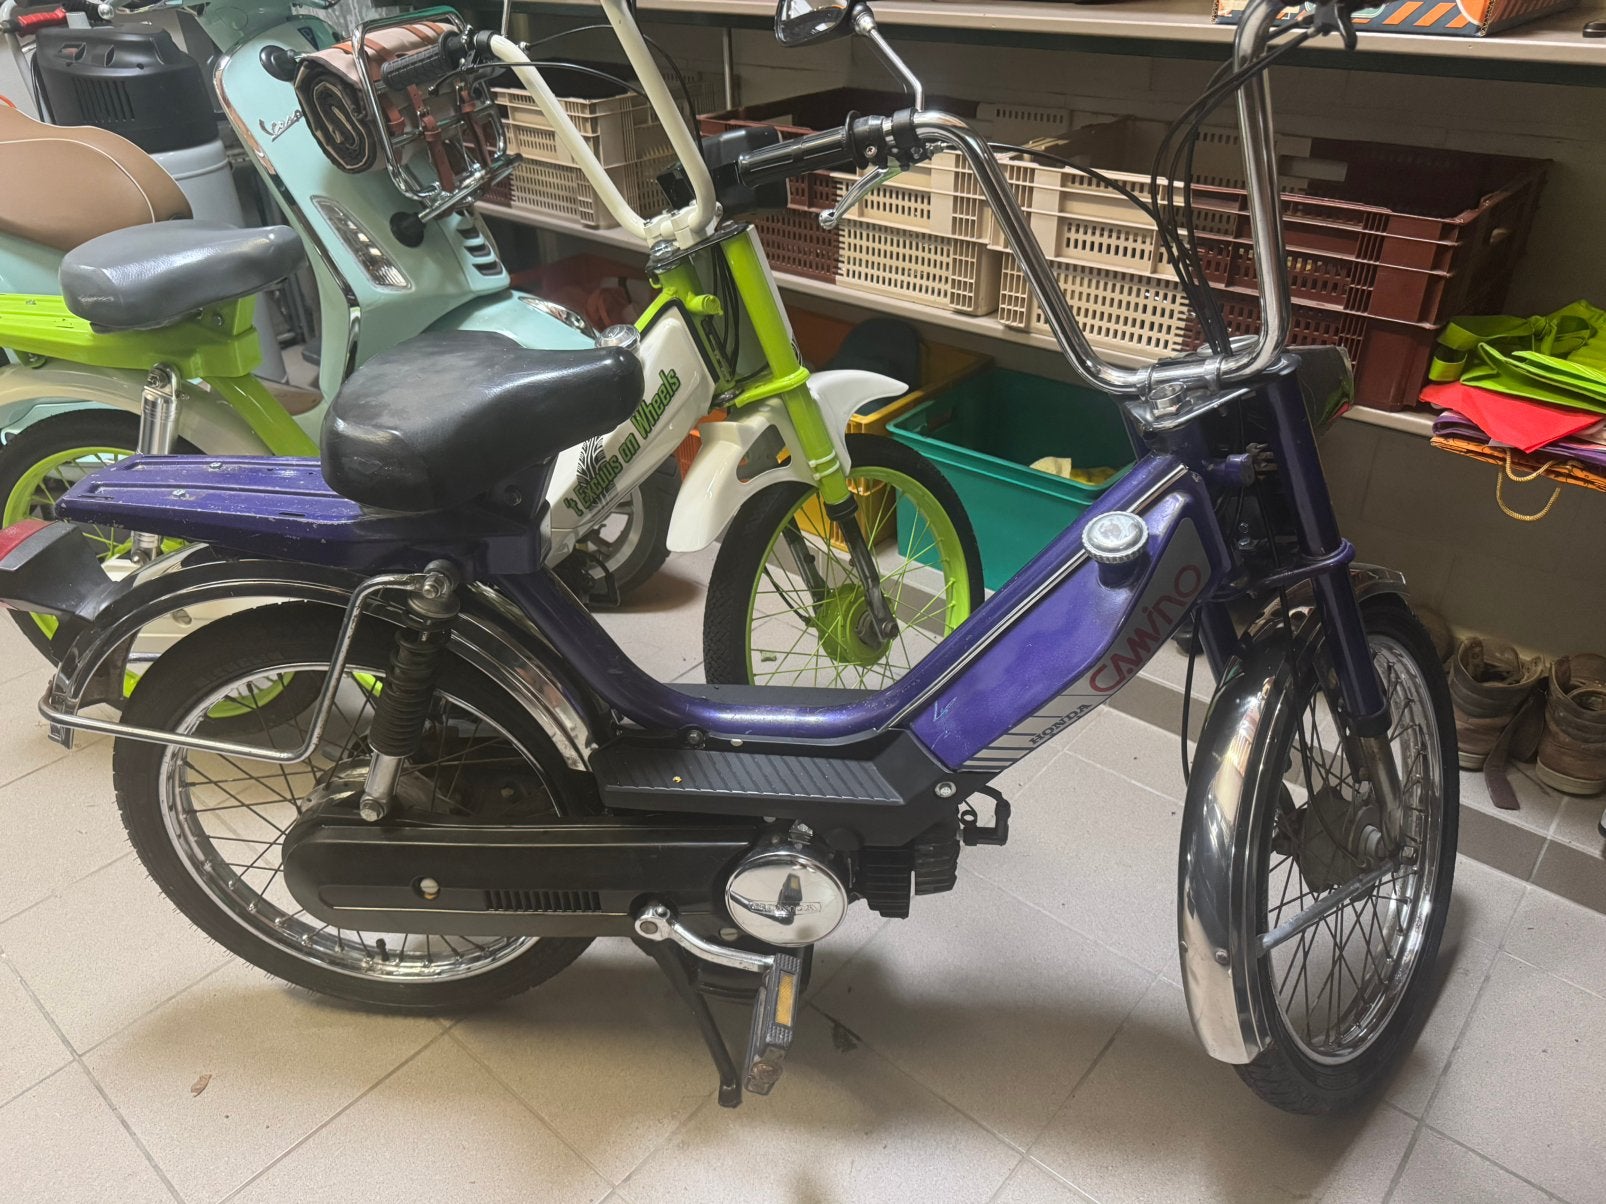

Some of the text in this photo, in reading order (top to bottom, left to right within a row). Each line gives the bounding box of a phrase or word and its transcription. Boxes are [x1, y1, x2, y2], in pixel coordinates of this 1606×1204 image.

[629, 369, 681, 440] Wheels
[618, 432, 641, 463] on
[573, 455, 624, 509] Excuus
[1028, 703, 1092, 746] HONDA
